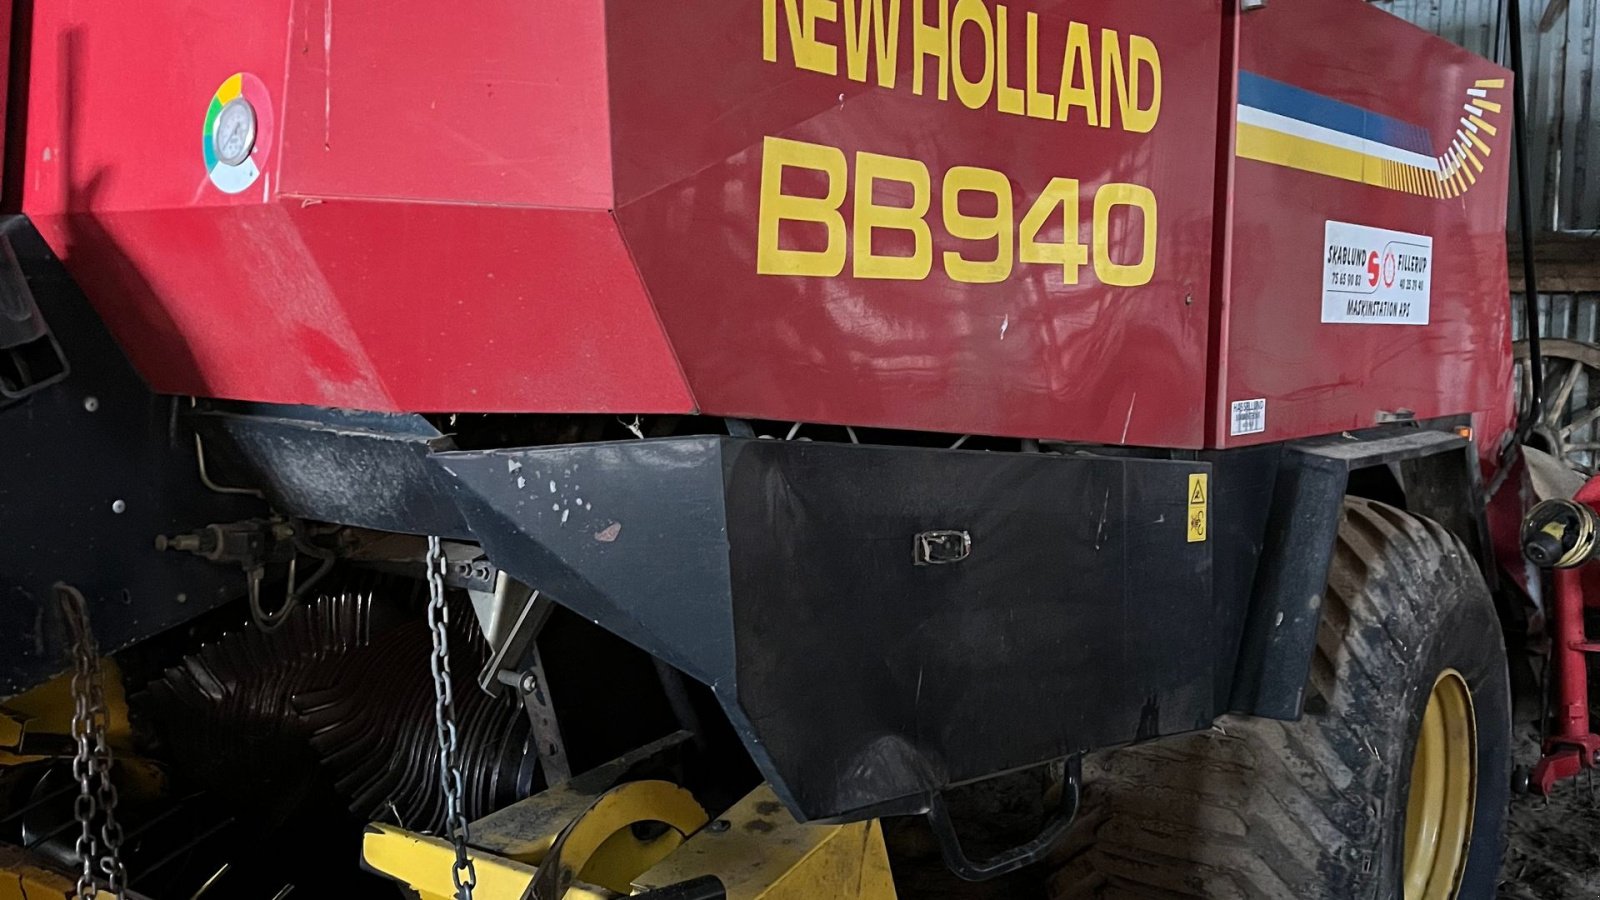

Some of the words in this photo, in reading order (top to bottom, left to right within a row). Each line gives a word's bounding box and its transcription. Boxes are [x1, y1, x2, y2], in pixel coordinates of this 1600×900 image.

[912, 0, 1161, 133] HOLLAND
[757, 136, 1157, 287] BB940
[1327, 245, 1367, 268] SKABLUND
[1397, 254, 1428, 273] FILLERUP
[1331, 272, 1339, 285] 75
[1346, 299, 1398, 317] MASKINSTATION
[1399, 303, 1411, 318] APS
